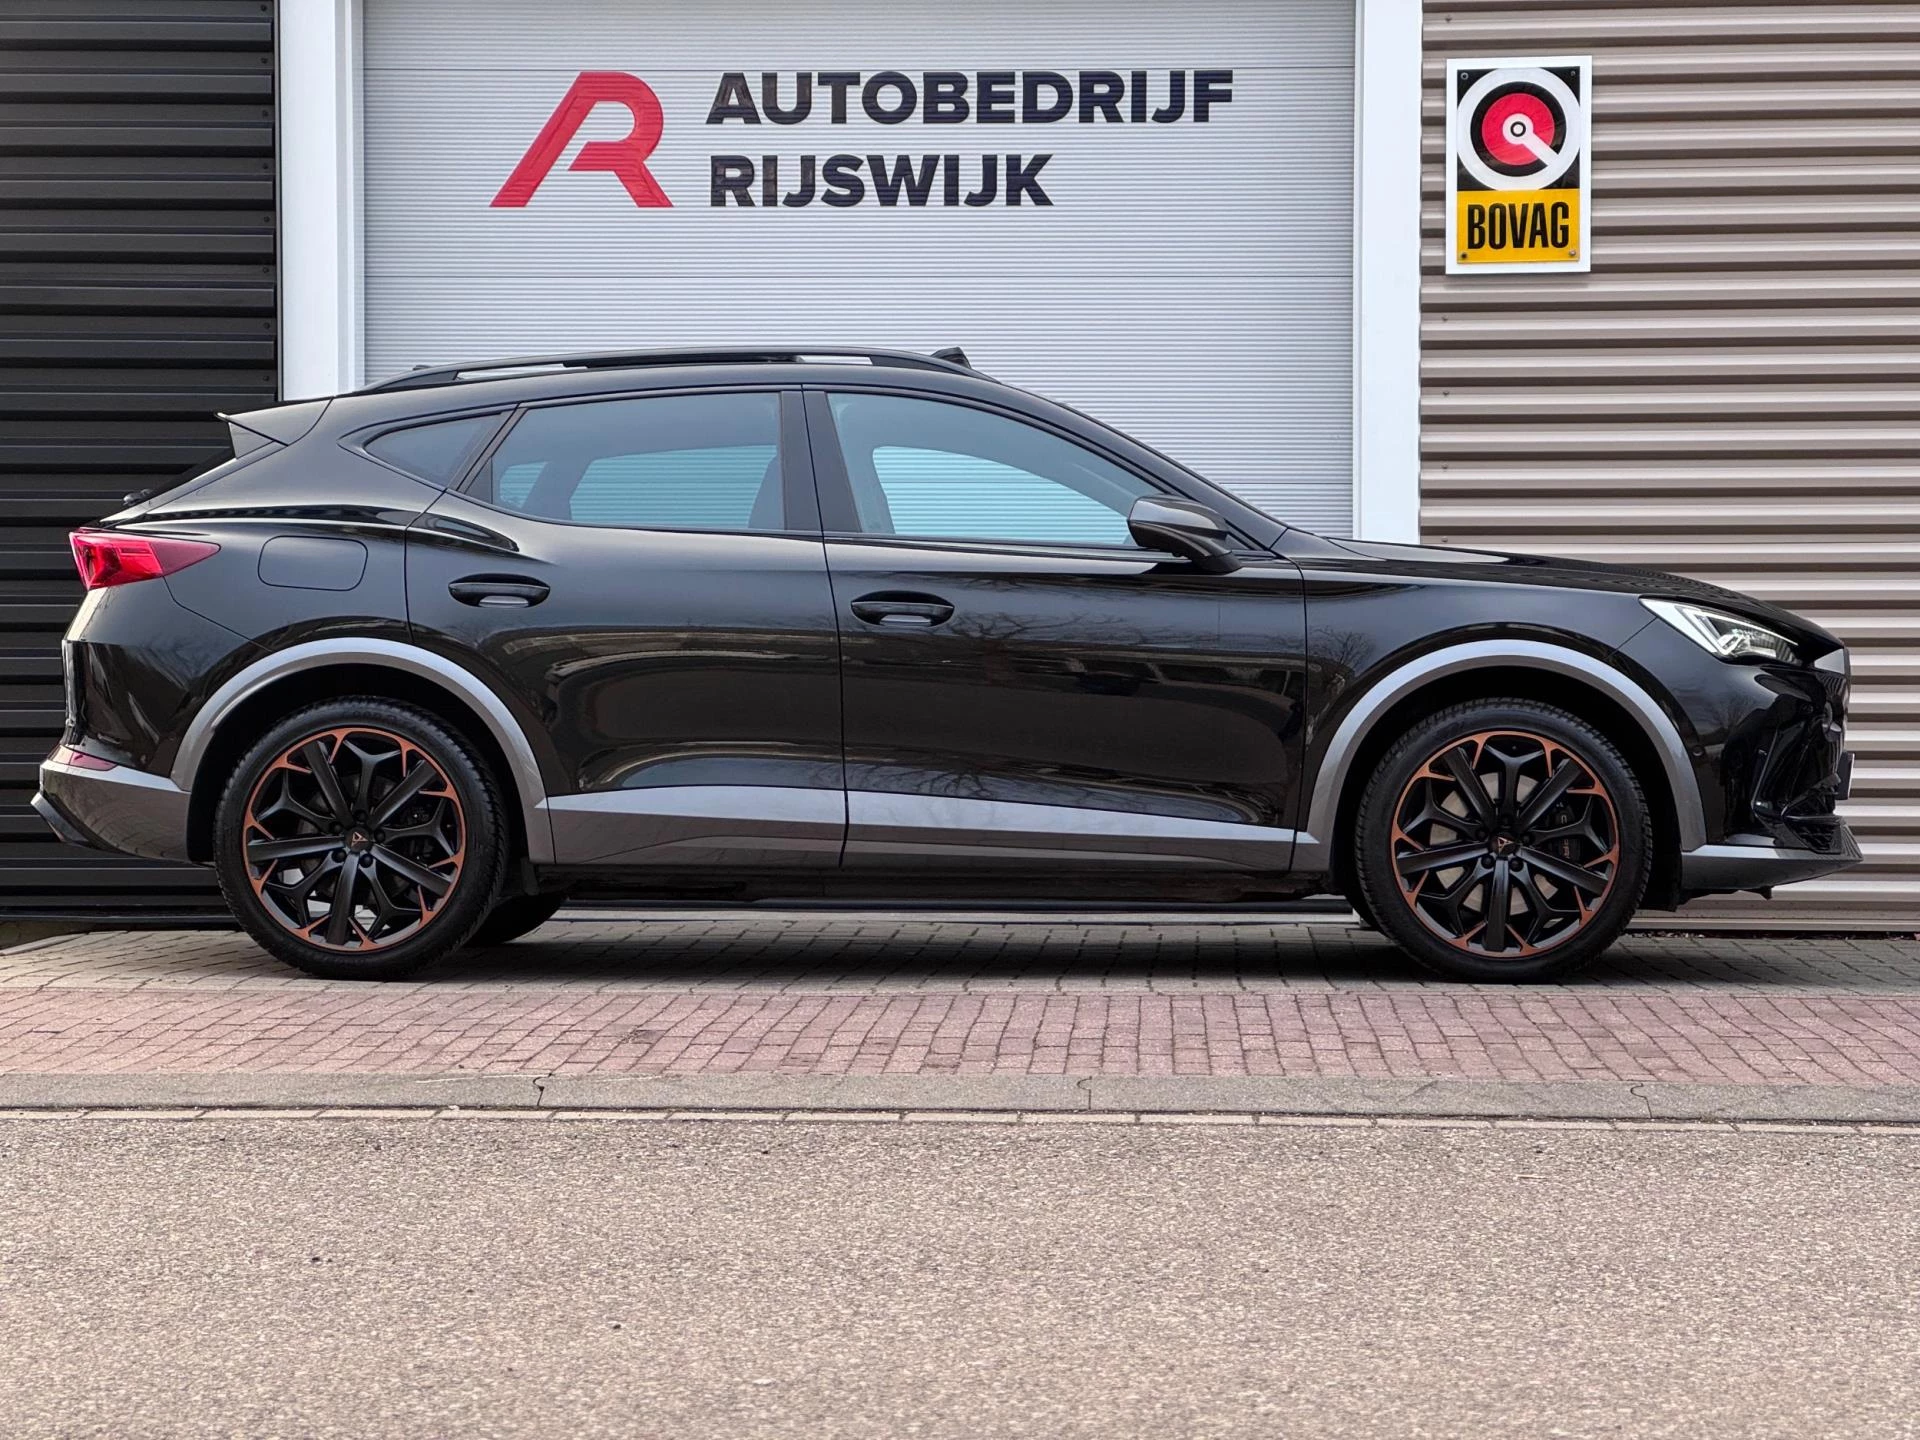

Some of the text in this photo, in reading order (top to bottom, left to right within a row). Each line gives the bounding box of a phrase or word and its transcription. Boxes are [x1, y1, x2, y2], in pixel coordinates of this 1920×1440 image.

[705, 70, 1233, 125] AUTOBEDRIJF
[710, 153, 1054, 208] RIJSWIJK
[1467, 201, 1570, 250] BOVAG
